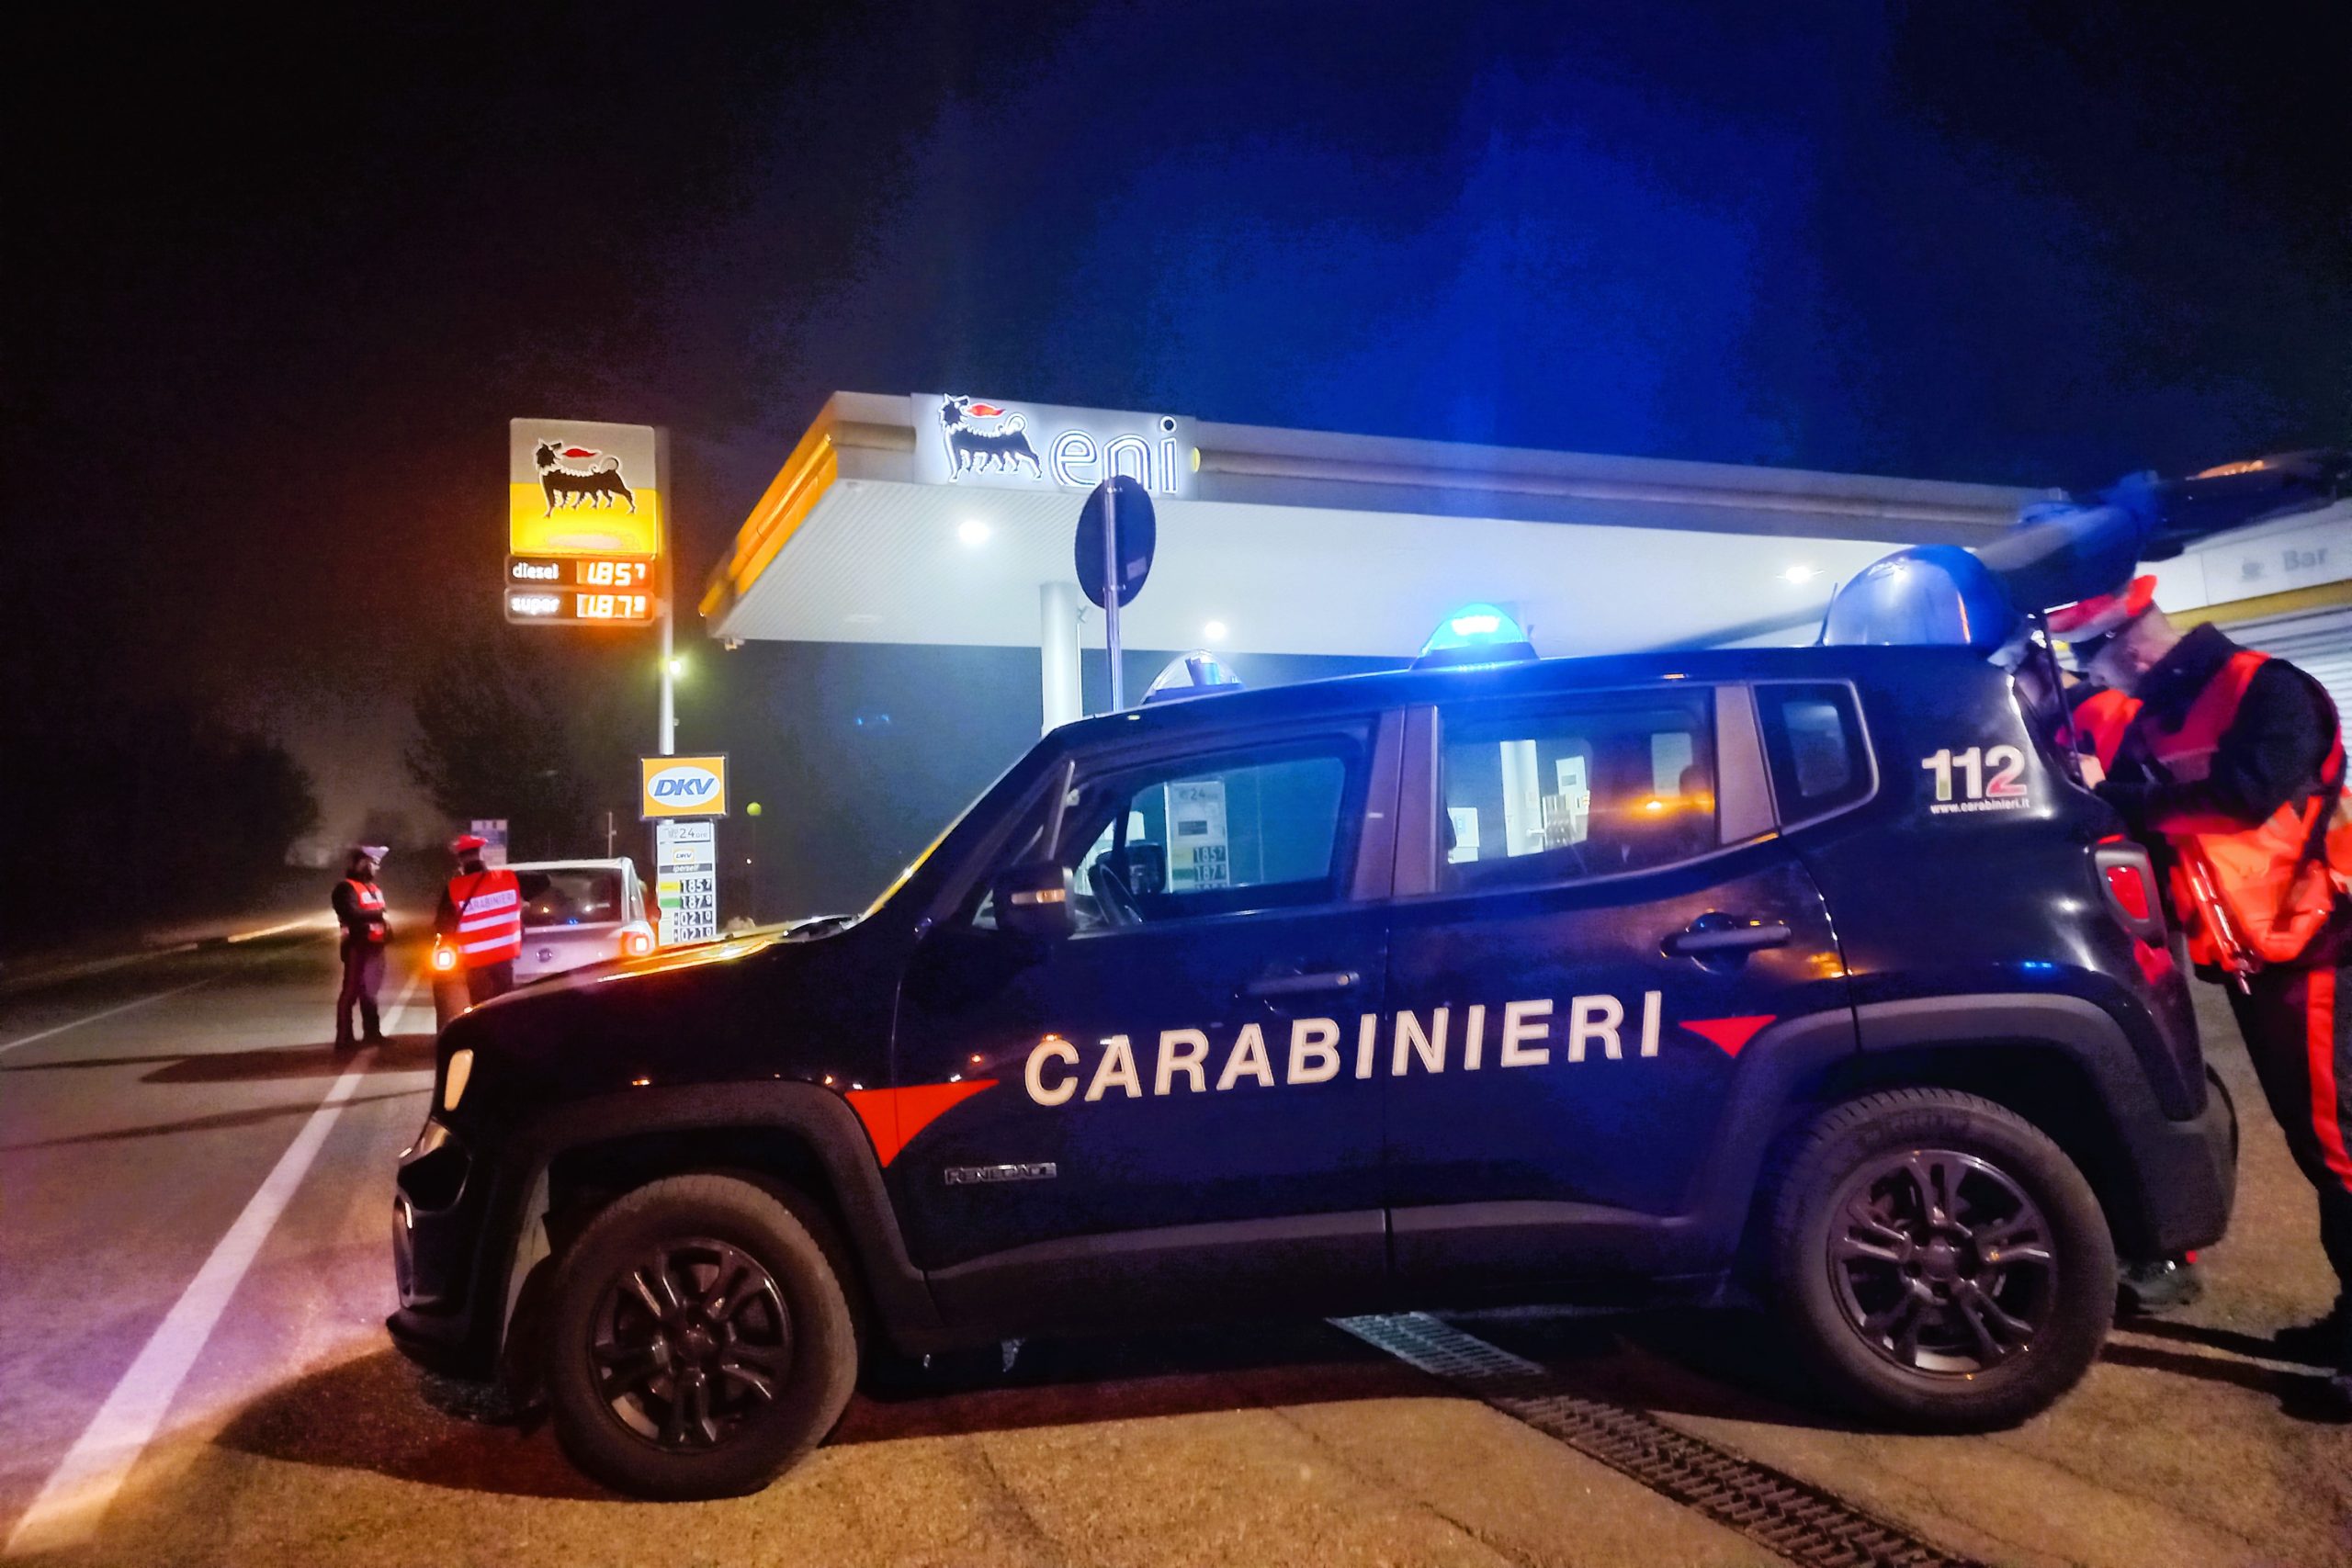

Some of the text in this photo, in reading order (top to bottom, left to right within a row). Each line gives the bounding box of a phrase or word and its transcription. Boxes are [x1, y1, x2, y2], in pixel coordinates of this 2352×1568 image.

[1050, 416, 1179, 494] eni
[512, 562, 560, 580] diesel
[511, 596, 560, 615] super
[1921, 744, 2028, 801] 112
[653, 777, 716, 796] DKV
[1930, 798, 2030, 815] www.carabinieri.it
[679, 828, 695, 839] 24
[681, 878, 711, 893] 1857
[465, 890, 514, 913] ARABINIERI
[1023, 990, 1664, 1106] CARABINIERI
